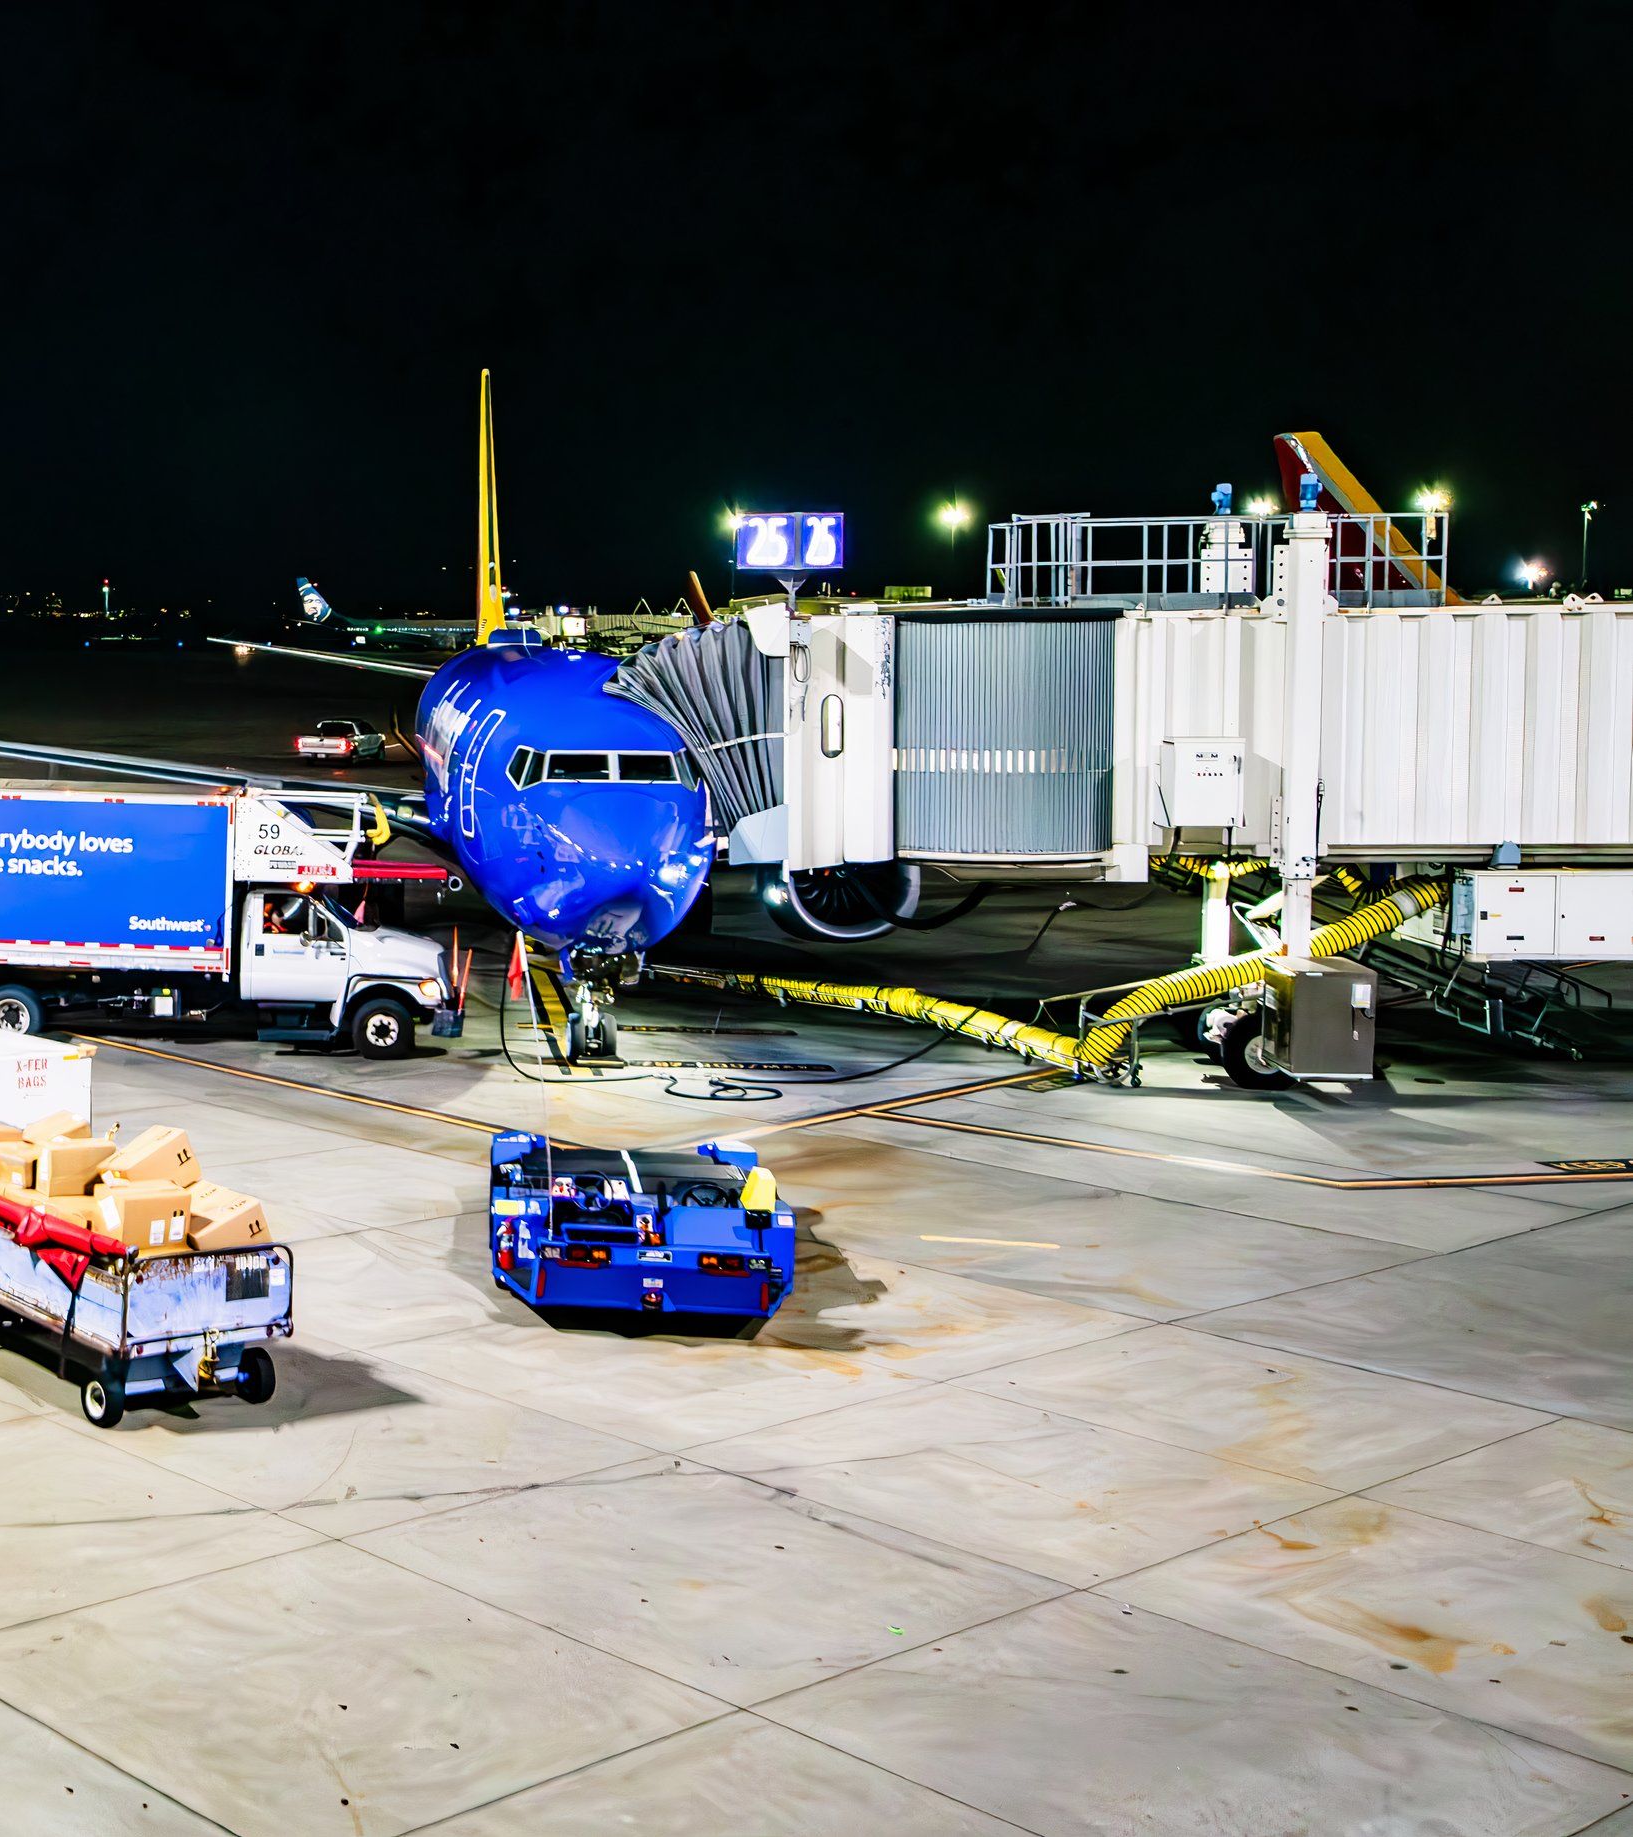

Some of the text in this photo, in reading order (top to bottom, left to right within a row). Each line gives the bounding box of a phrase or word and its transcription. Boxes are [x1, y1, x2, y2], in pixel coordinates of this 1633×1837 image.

[746, 517, 788, 566] 25
[806, 517, 836, 566] 25
[258, 824, 280, 839] 59
[79, 831, 133, 853] loves
[253, 844, 303, 856] GLOBA
[7, 855, 83, 877] snacks.
[128, 916, 205, 932] Southwest
[17, 1076, 47, 1089] BAGS
